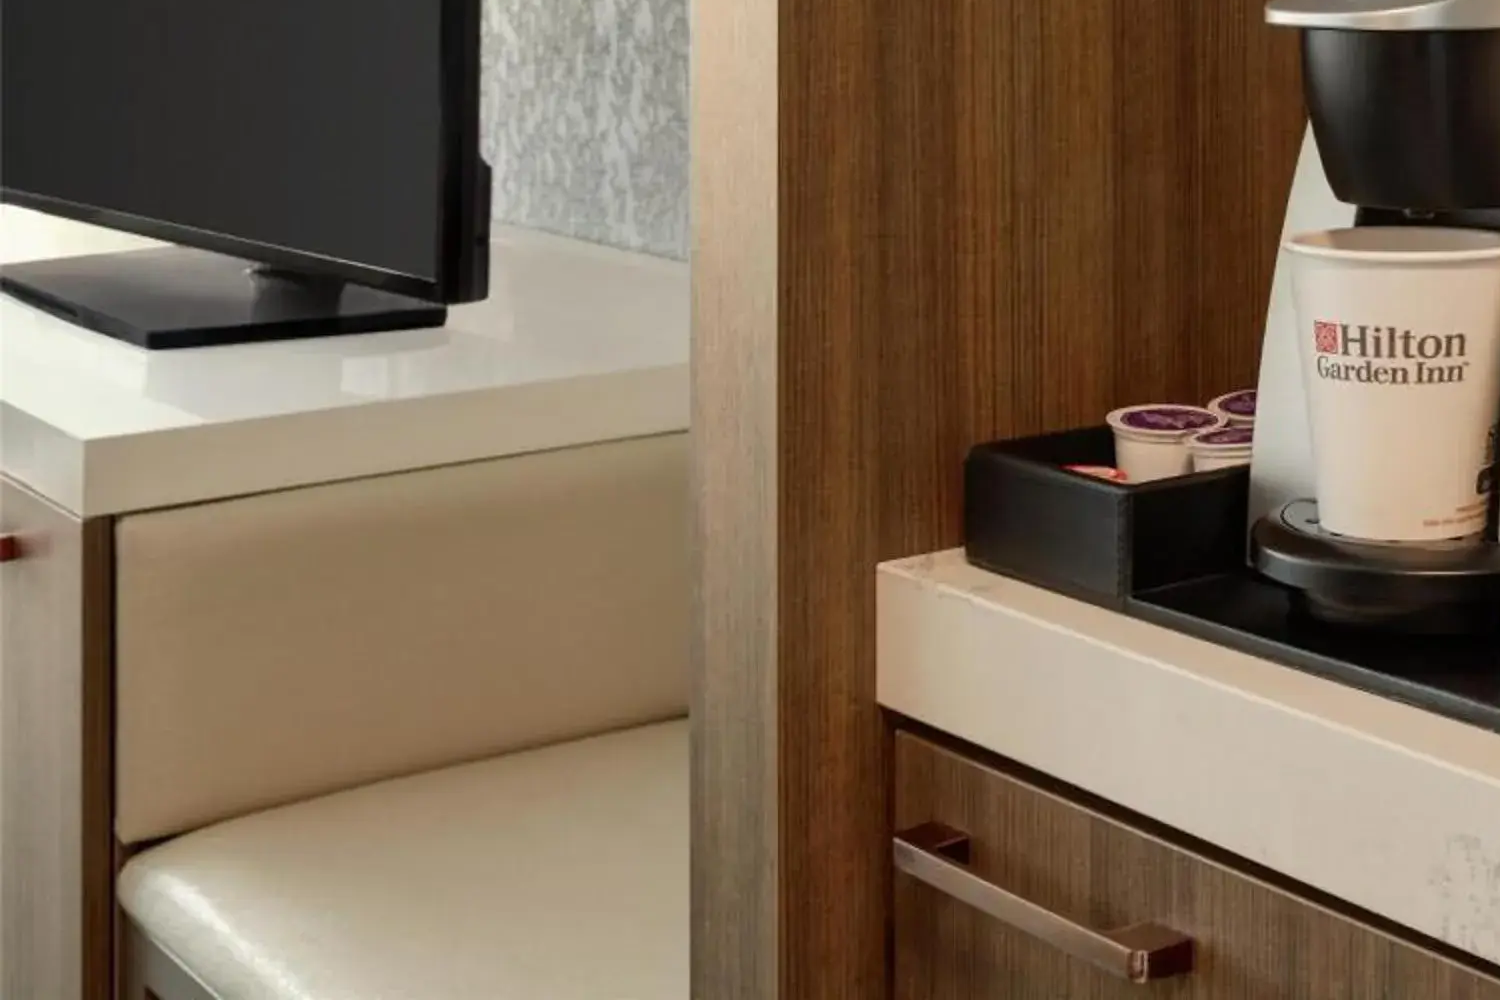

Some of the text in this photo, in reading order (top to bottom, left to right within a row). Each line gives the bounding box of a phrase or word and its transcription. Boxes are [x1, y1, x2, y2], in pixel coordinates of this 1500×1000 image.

[1338, 324, 1467, 360] Hilton
[1316, 355, 1467, 385] Garden Inn
